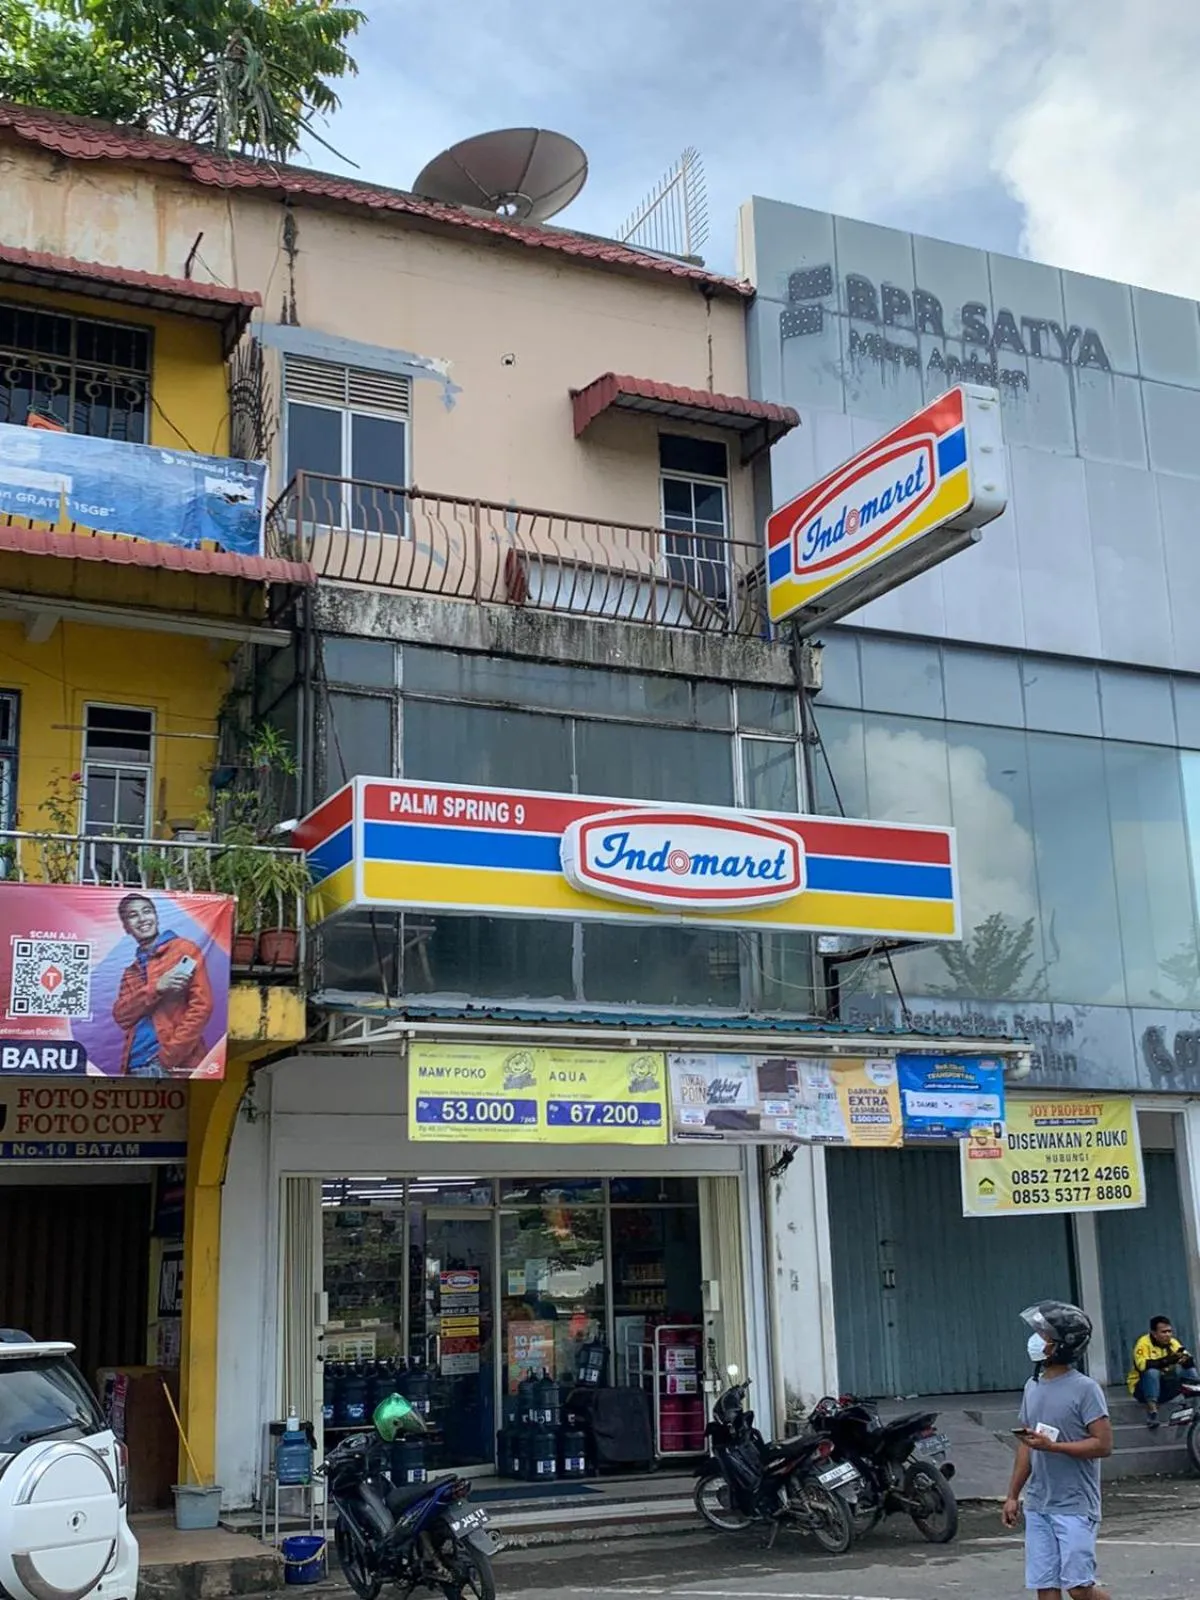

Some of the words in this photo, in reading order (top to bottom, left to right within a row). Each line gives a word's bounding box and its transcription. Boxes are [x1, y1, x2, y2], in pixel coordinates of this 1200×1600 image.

[845, 273, 944, 336] BPR
[962, 303, 1110, 371] SATYA
[803, 455, 925, 561] Indomaret
[390, 791, 437, 816] PALM
[443, 797, 510, 823] SPRING
[514, 804, 525, 825] 9
[595, 832, 787, 881] Indomaret
[30, 930, 57, 940] SCAN
[60, 932, 78, 940] AJA
[2, 1047, 78, 1070] BARU
[419, 1067, 453, 1078] MAMY
[454, 1067, 487, 1078] POKO
[549, 1071, 587, 1082] AQUA
[17, 1089, 89, 1109] FOTO
[92, 1089, 185, 1110] STUDIO
[848, 1096, 888, 1106] EXTRA
[442, 1101, 515, 1121] 53.000
[570, 1105, 638, 1124] 67.200
[1028, 1105, 1050, 1118] JOY
[1051, 1103, 1104, 1117] PROPERTY
[16, 1114, 89, 1134] FOTO
[94, 1114, 165, 1134] COPY
[1007, 1132, 1082, 1150] DISEWAKAN
[1086, 1131, 1093, 1146] 2
[1096, 1129, 1128, 1146] RUKO
[13, 1143, 67, 1156] No.10
[76, 1143, 140, 1156] BATAM
[1045, 1153, 1089, 1163] HUBUNGI
[1012, 1169, 1048, 1185] 0852
[1054, 1168, 1089, 1182] 7212
[1094, 1166, 1130, 1180] 4266
[1012, 1188, 1050, 1204] 0853
[1055, 1187, 1091, 1202] 5377
[1096, 1185, 1132, 1200] 8880
